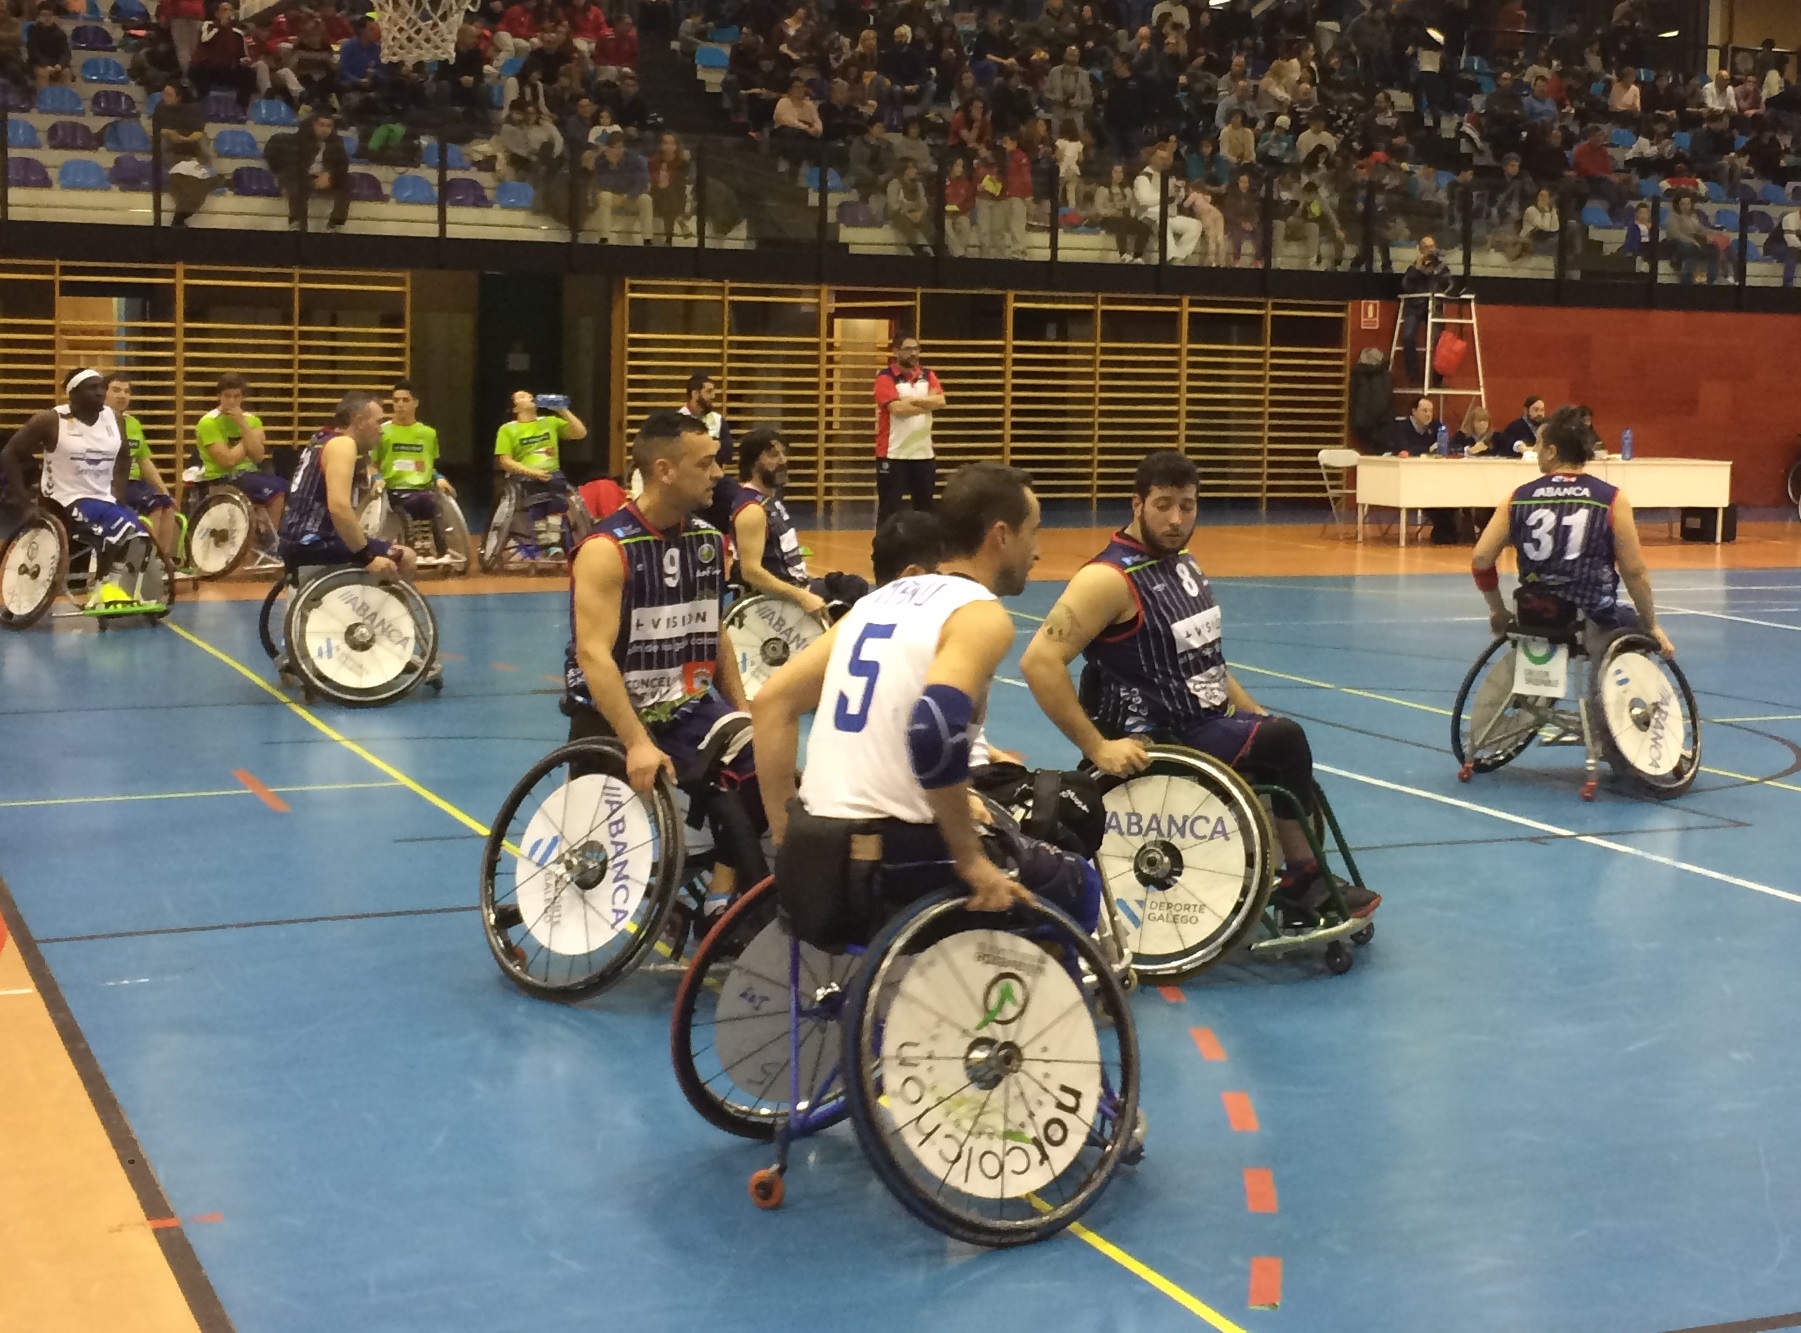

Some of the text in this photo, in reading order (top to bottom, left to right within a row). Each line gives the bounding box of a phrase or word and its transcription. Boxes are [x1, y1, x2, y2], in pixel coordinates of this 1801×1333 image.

[1532, 487, 1591, 497] ABANCA
[1523, 508, 1590, 561] 31
[663, 548, 681, 588] 9
[1175, 562, 1199, 597] 8
[343, 595, 410, 651] ABANCA
[760, 610, 809, 651] ABAN
[834, 622, 897, 733] 5
[1104, 811, 1231, 841] ABANCA
[604, 796, 630, 929] ABANCA
[1147, 914, 1199, 925] GALEGO
[1149, 901, 1207, 914] DEPORTE
